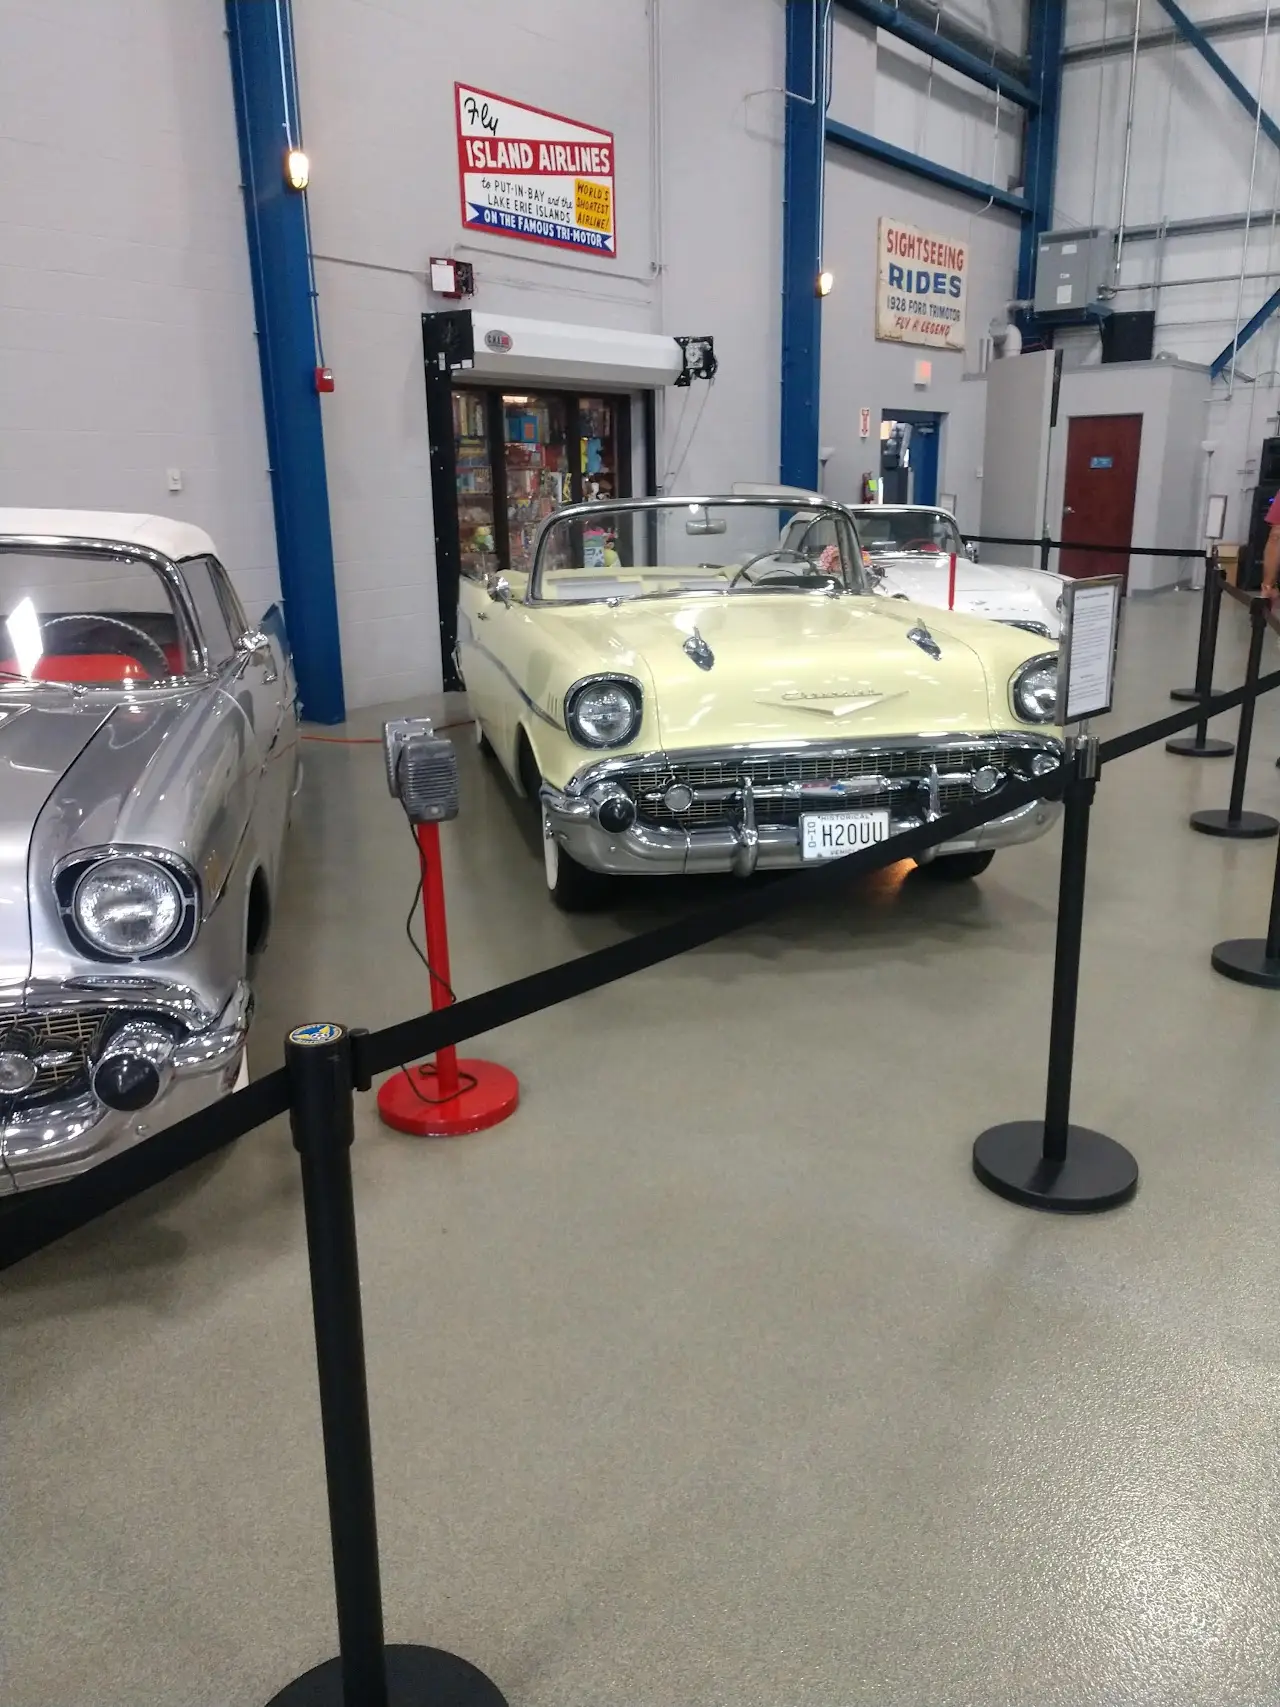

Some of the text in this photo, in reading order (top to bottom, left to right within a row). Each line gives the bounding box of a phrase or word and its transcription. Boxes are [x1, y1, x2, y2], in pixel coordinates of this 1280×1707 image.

[464, 97, 499, 136] Fly
[465, 140, 611, 174] ISLAND AIRLINES
[481, 177, 573, 209] to PUT-IN-BAY and the
[488, 193, 571, 223] LAKE ERIE ISLANDS
[576, 196, 610, 216] SHORTEST
[484, 209, 603, 248] ON THE FAMOUS TRI-MOTOR
[576, 211, 610, 230] AIRLINE!
[887, 229, 963, 271] SIGHTSEEING
[888, 262, 961, 298] RIDES
[887, 295, 961, 323] 1928 FORD TRIMOTOR
[895, 315, 952, 337] FLY A LEGEND
[807, 821, 817, 849] OHIO
